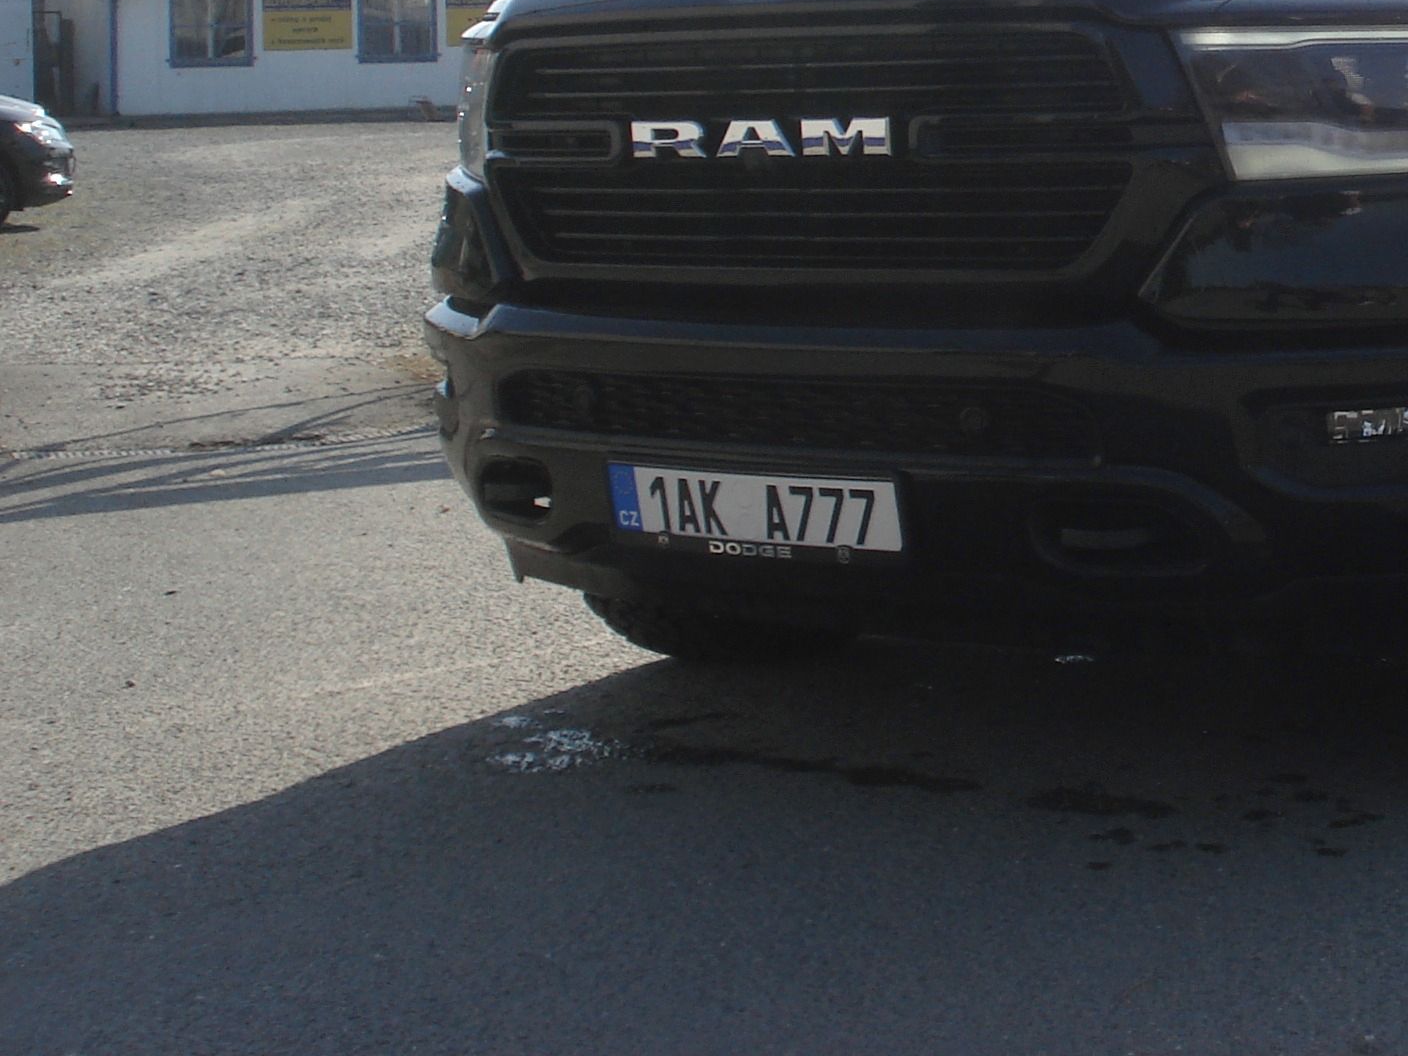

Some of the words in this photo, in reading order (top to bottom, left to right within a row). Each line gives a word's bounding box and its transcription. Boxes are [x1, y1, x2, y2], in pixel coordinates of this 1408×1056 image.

[631, 116, 892, 159] RAM
[619, 510, 640, 527] CZ
[649, 476, 728, 536] 1AK
[765, 484, 875, 545] A777
[708, 540, 793, 559] DODGE
